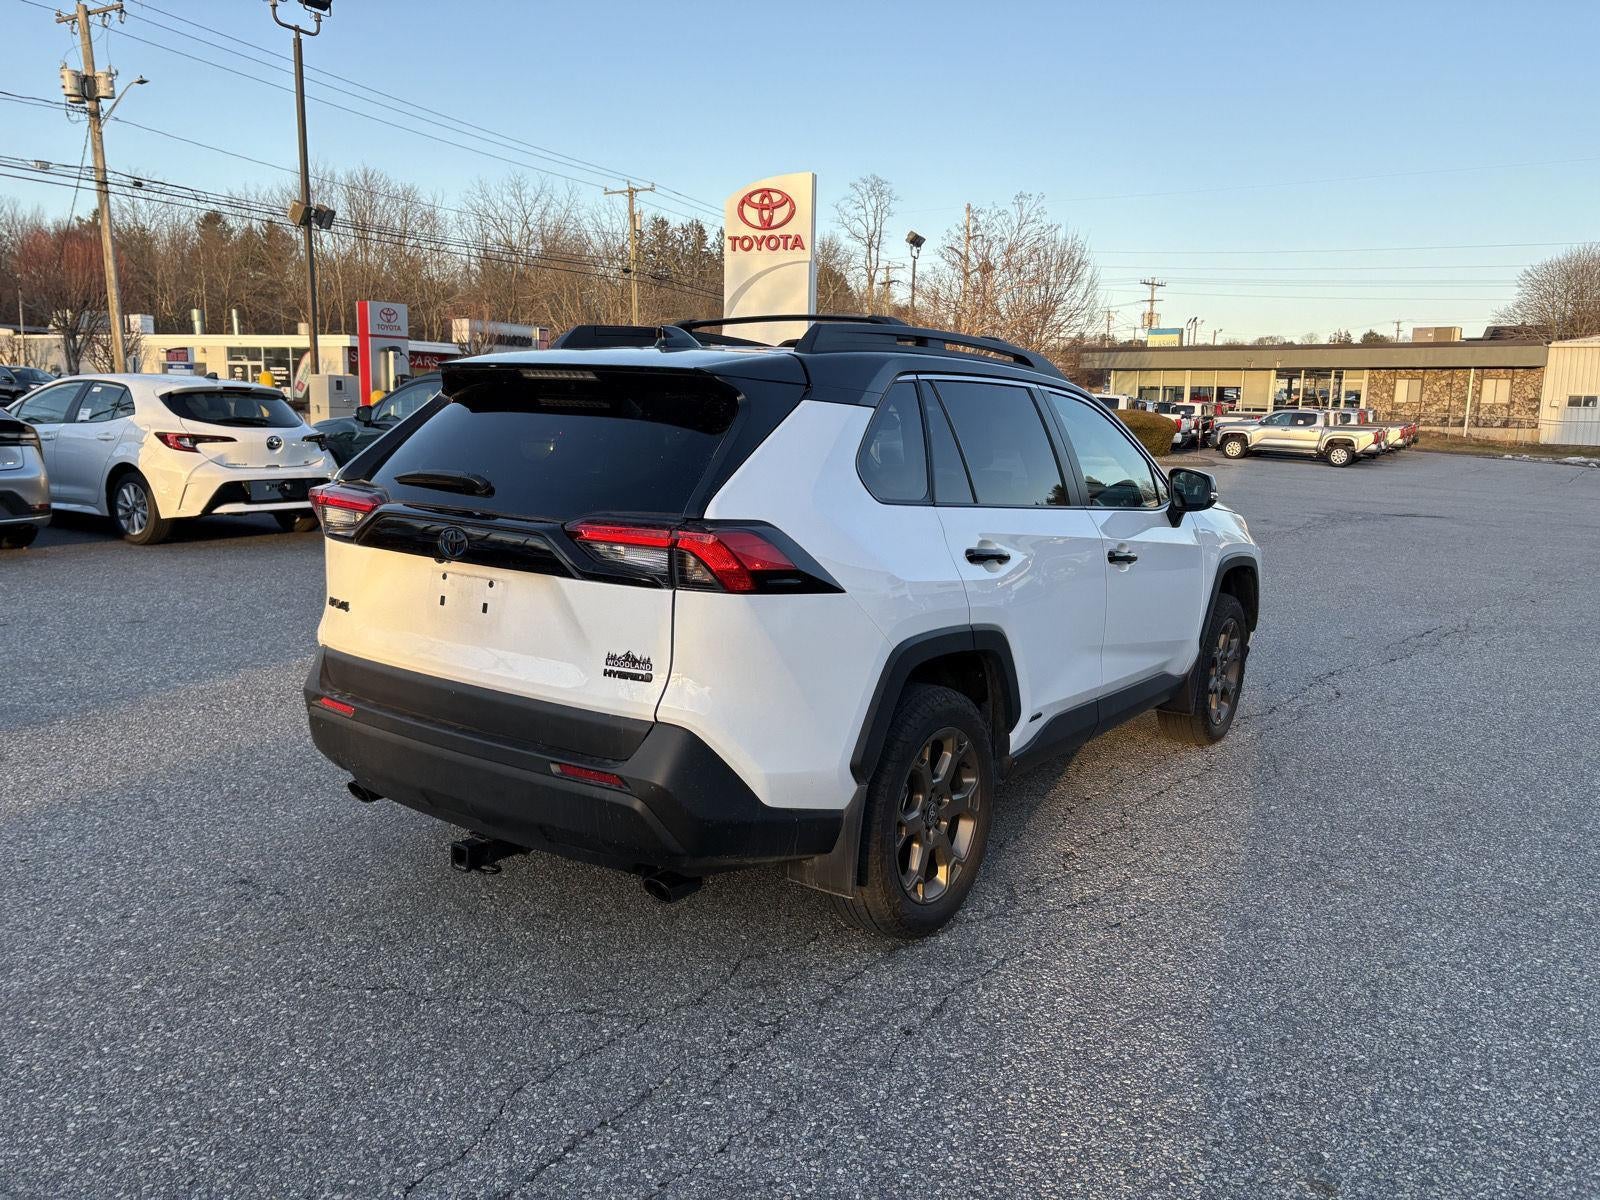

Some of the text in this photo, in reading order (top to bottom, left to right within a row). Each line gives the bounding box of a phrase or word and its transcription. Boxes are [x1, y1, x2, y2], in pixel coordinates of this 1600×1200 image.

[728, 234, 805, 252] TOYOTA
[409, 353, 439, 367] CARS
[606, 659, 652, 671] WOODLAND
